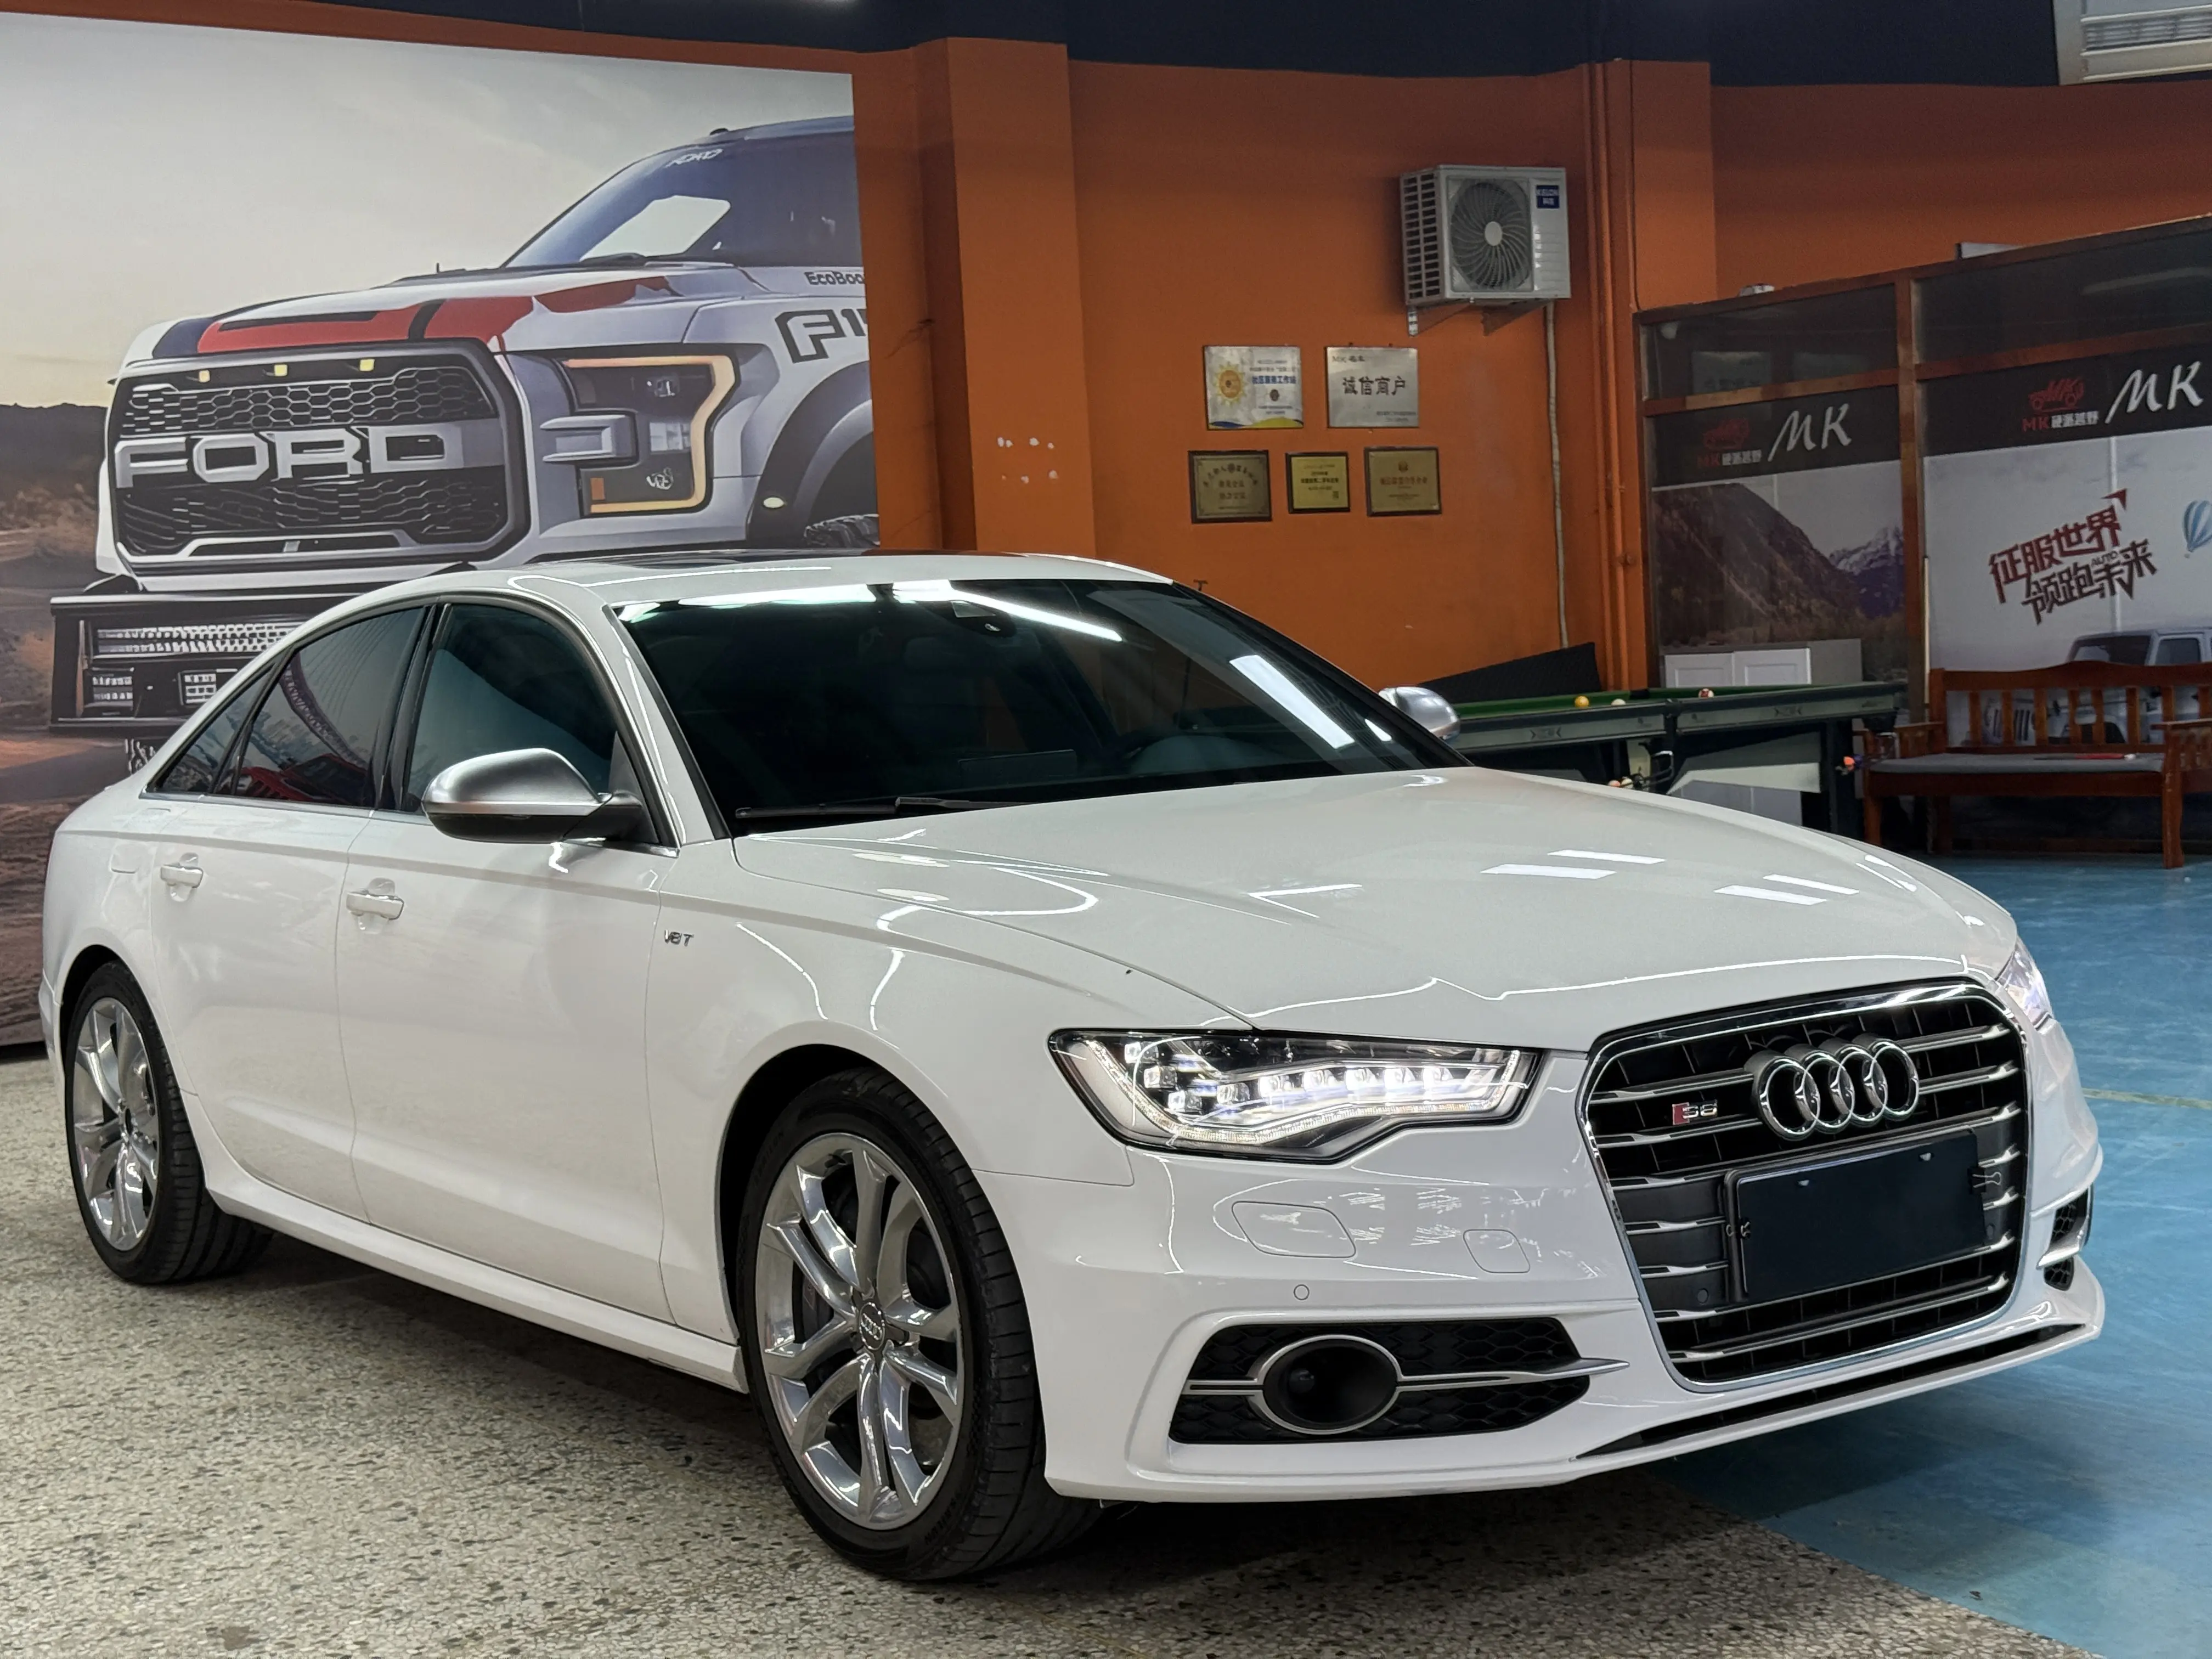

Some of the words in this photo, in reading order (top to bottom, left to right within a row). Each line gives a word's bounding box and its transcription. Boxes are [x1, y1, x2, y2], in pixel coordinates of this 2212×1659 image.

[1342, 375, 1406, 396] 诚信商户
[2105, 360, 2204, 424] MK
[114, 422, 464, 489] FORD
[1768, 403, 1852, 462] MK
[1989, 505, 2122, 604] 征服世界
[2021, 538, 2158, 625] 领跑未来
